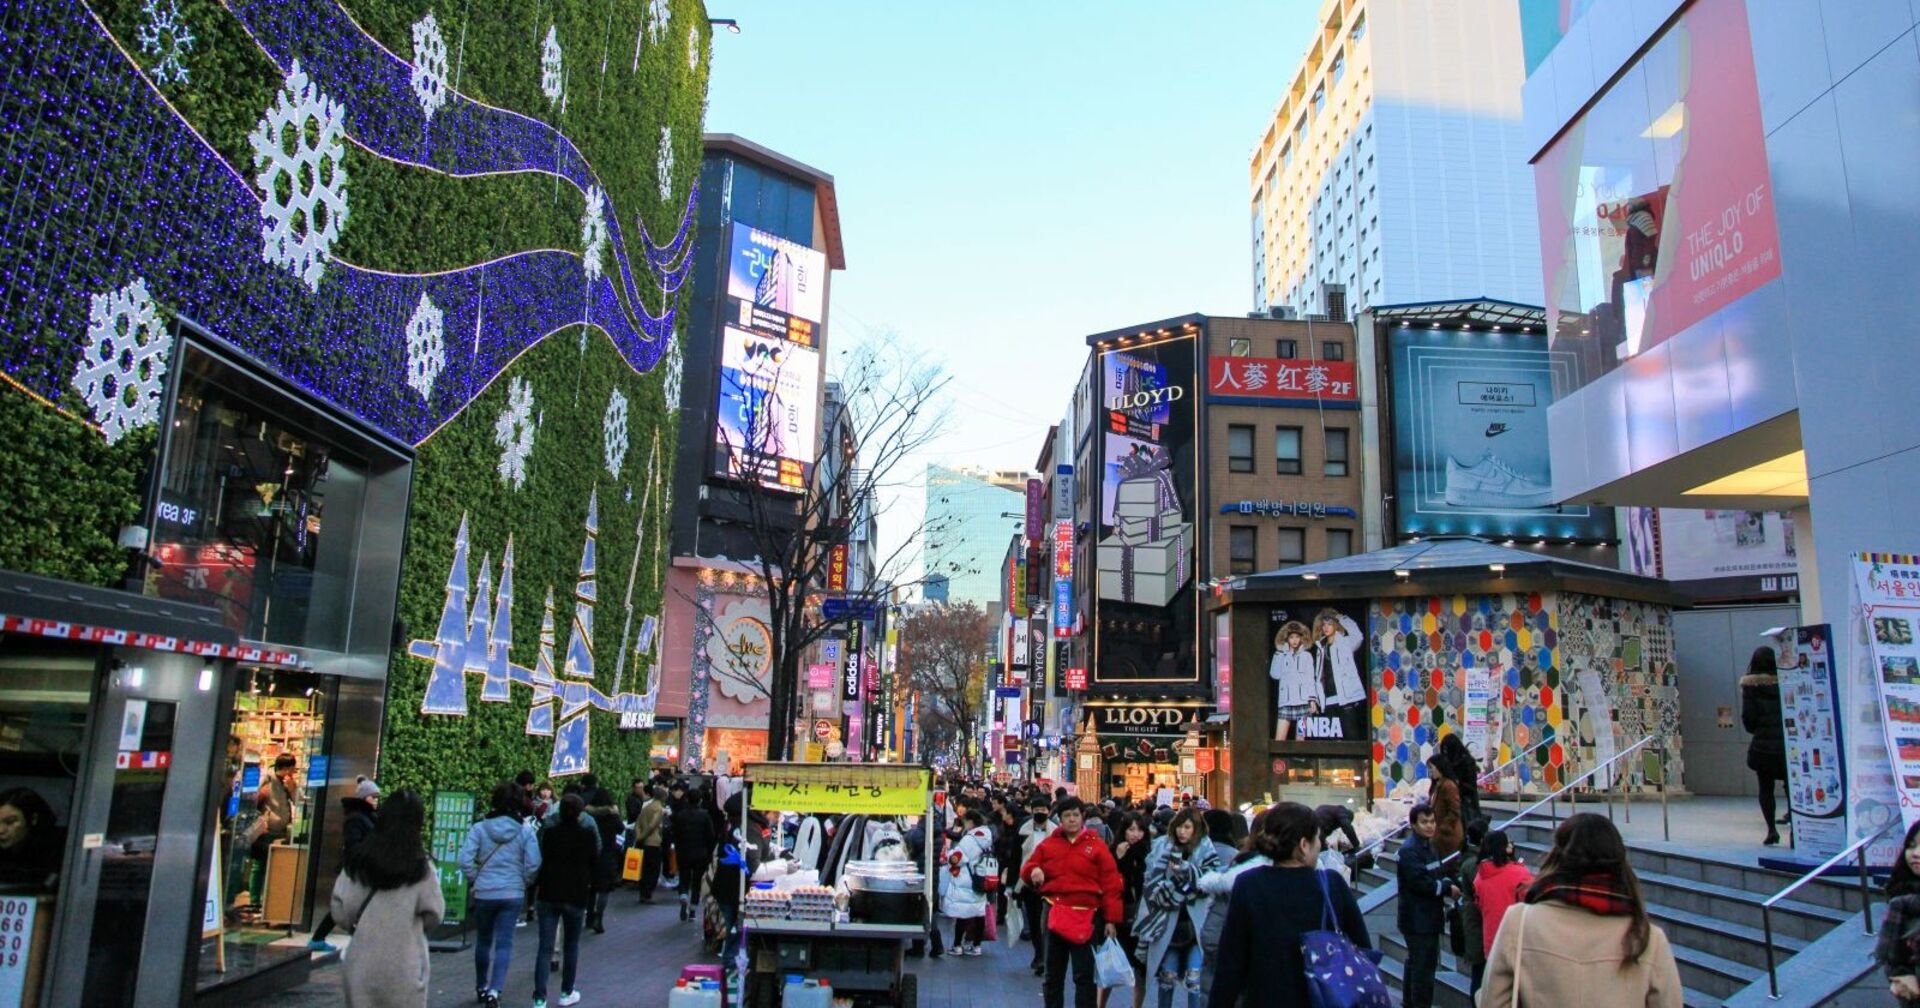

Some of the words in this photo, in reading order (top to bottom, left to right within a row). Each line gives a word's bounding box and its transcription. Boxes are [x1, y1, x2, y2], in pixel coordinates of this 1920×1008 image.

[1686, 221, 1714, 256] THE
[1718, 200, 1742, 237] JOY
[1746, 184, 1765, 216] OF
[1690, 230, 1743, 281] UNIQLO
[1111, 385, 1184, 411] LLOYD
[1331, 381, 1353, 395] 2F
[1486, 387, 1508, 395] 나이키
[1489, 422, 1506, 431] NIKE
[181, 508, 196, 525] 3F
[1035, 642, 1044, 671] YEON
[848, 654, 858, 696] adidas
[1105, 708, 1183, 725] LLOYD
[1306, 716, 1344, 737] NBA
